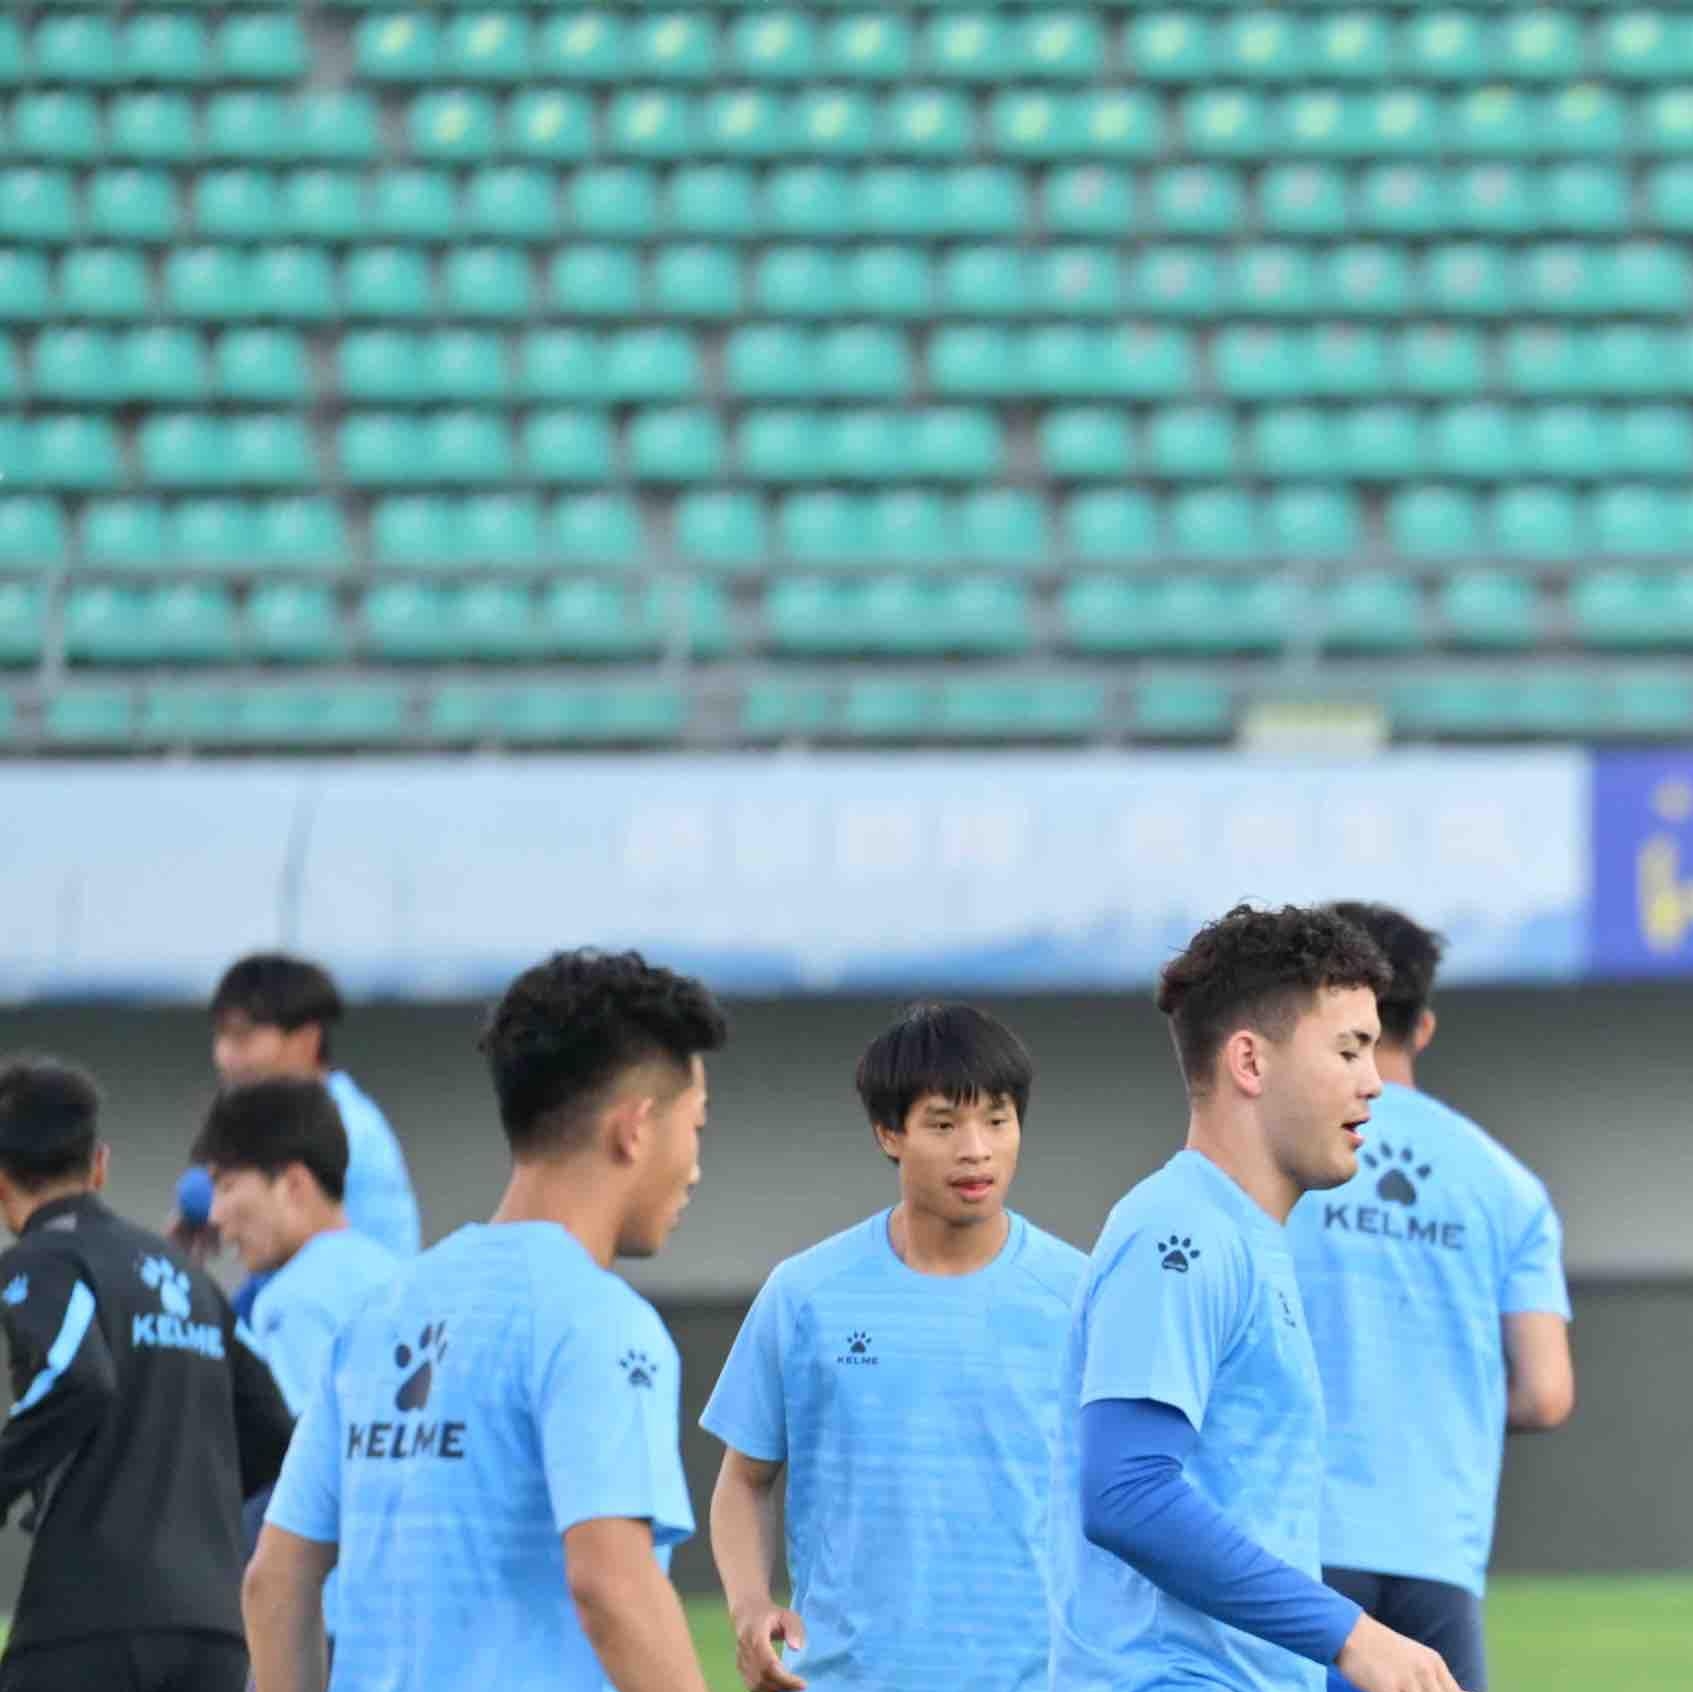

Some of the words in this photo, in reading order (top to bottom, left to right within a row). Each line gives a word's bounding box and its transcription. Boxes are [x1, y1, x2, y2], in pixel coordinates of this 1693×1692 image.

[1322, 1202, 1466, 1251] KELME
[132, 1313, 227, 1358] KELME
[837, 1356, 879, 1366] KELME
[346, 1422, 466, 1460] KELME
